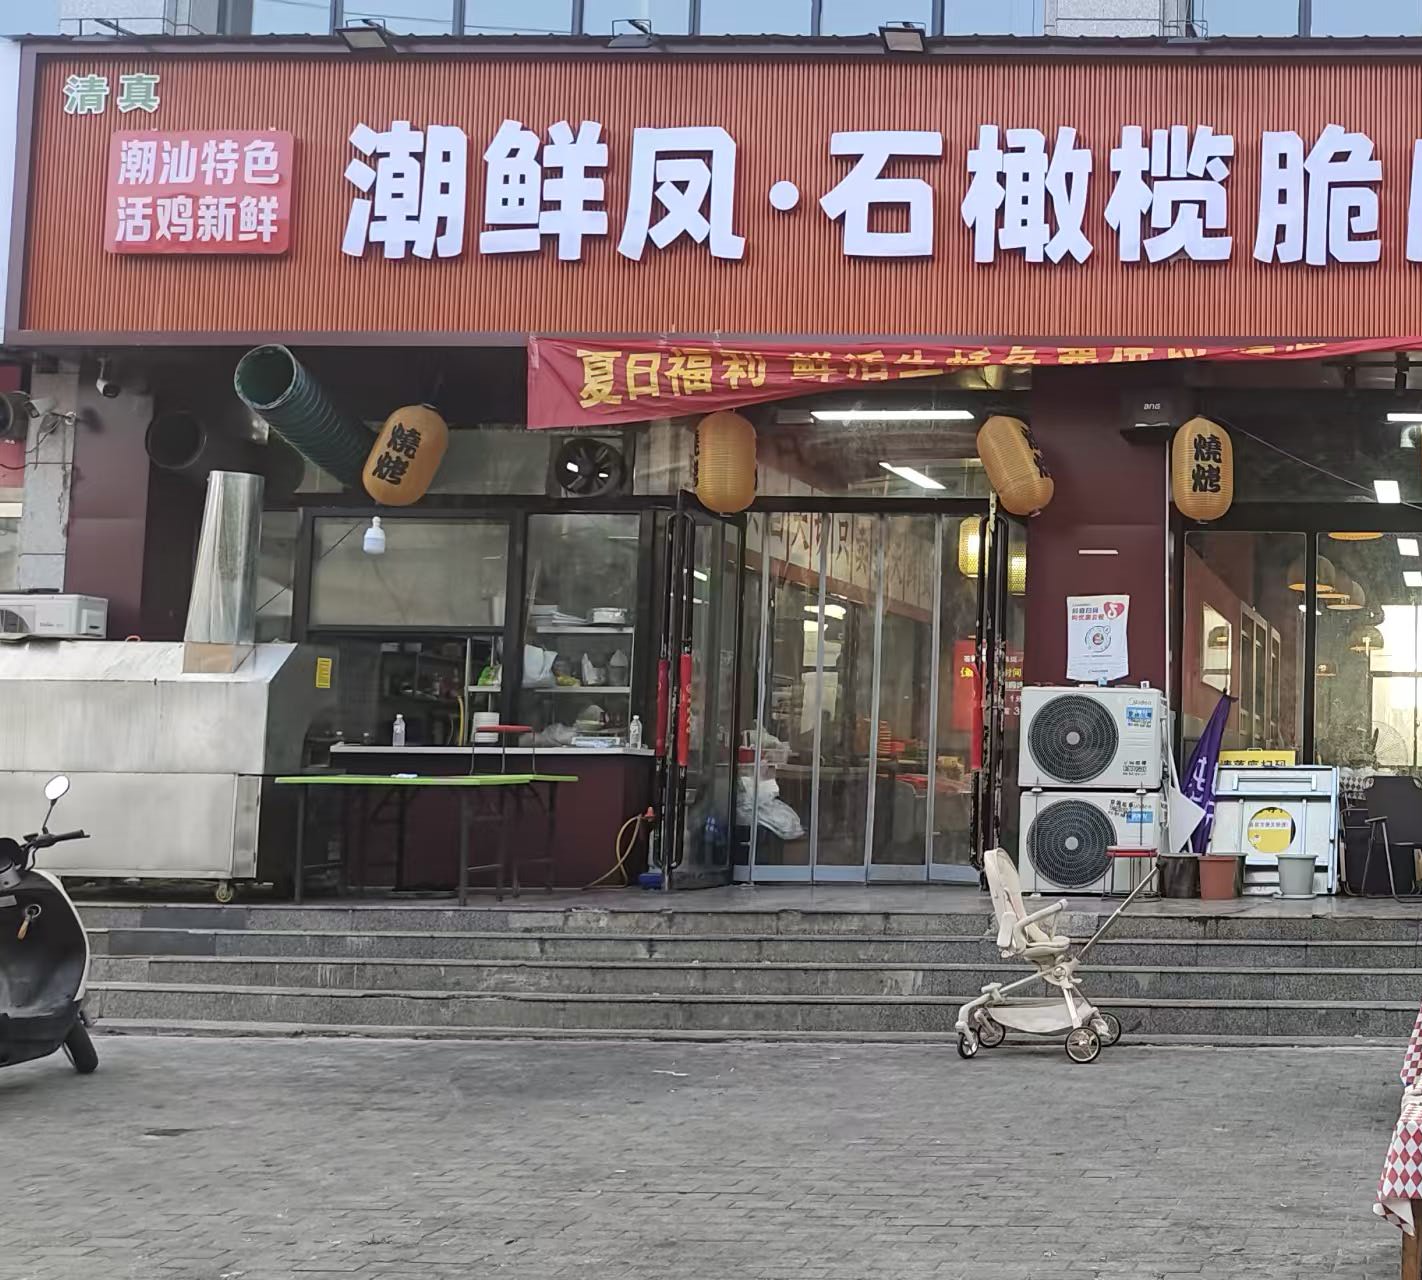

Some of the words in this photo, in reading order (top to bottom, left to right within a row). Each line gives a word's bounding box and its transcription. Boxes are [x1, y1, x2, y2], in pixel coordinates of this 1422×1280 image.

[64, 73, 160, 115] 清真
[118, 139, 280, 187] 潮汕特色
[115, 195, 279, 244] 活鸡新鲜
[577, 347, 767, 408] 夏日福利
